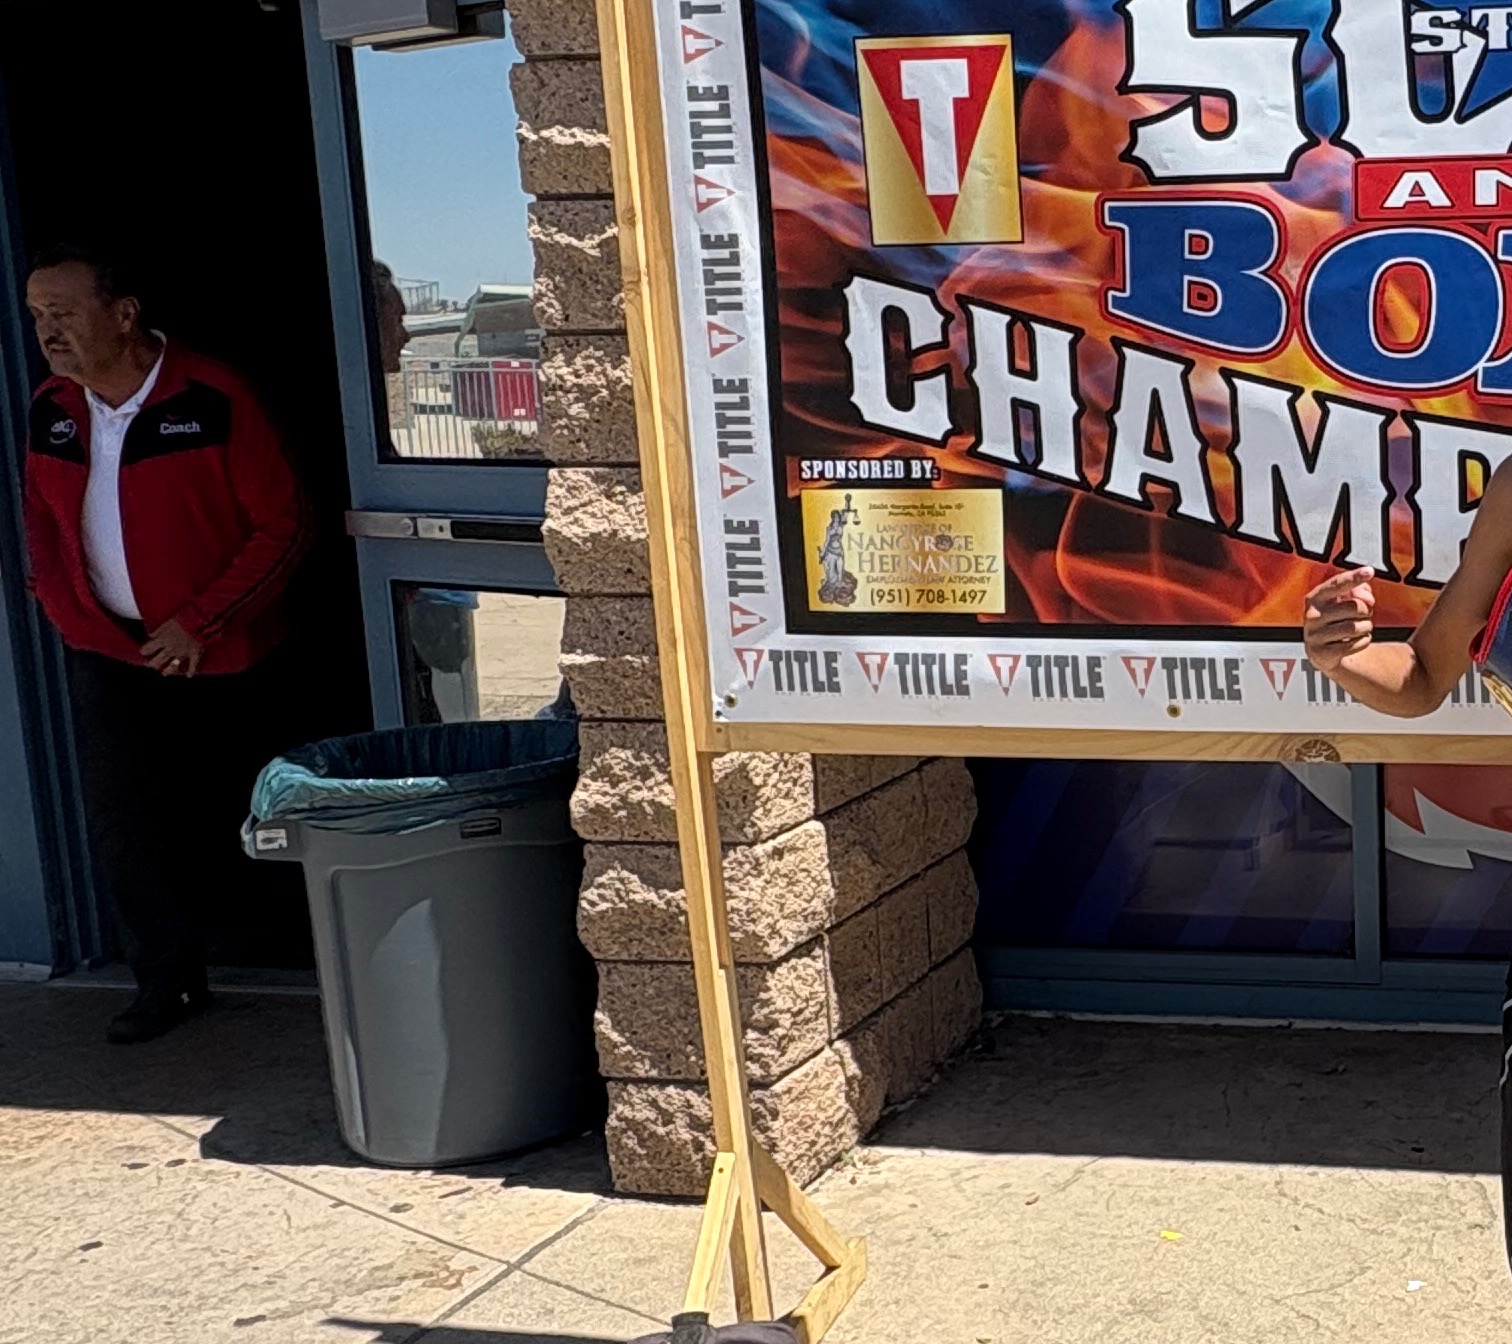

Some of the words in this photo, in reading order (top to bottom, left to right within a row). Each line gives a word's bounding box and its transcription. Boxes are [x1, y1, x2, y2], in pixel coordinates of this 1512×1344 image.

[687, 84, 735, 169] TITLE
[900, 58, 970, 196] T
[700, 233, 744, 316] TITLE
[159, 421, 201, 434] Coach
[713, 378, 755, 459] TITLE
[800, 460, 904, 479] SPONSORED
[911, 460, 938, 479] BY:
[724, 519, 765, 598] TITLE
[847, 532, 974, 551] NANCYRSE
[858, 552, 999, 574] HERNANDEZ
[870, 588, 910, 606] (951)
[916, 588, 987, 605] 708-1497
[768, 650, 841, 693] TITLE
[894, 652, 970, 696] TITLE
[1026, 654, 1104, 698] TITLE
[1161, 657, 1241, 701] TITLE
